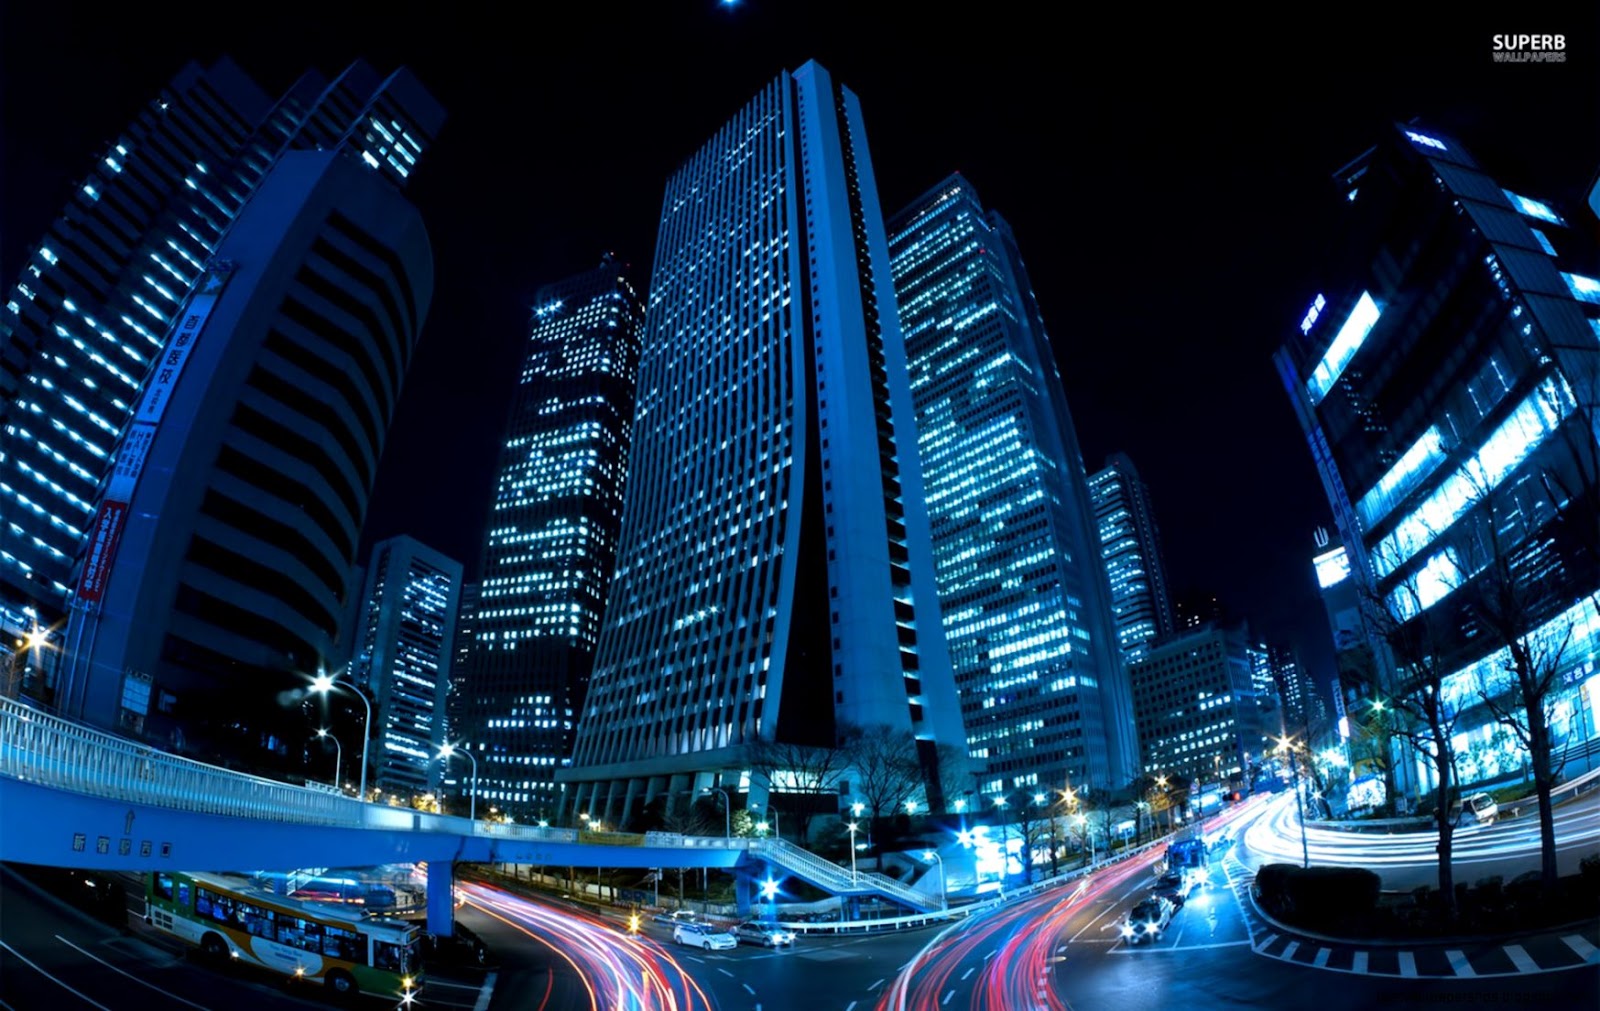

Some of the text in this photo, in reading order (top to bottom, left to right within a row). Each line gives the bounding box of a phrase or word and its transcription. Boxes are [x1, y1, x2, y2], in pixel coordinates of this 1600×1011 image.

[72, 832, 172, 858] 新宿駅西口
